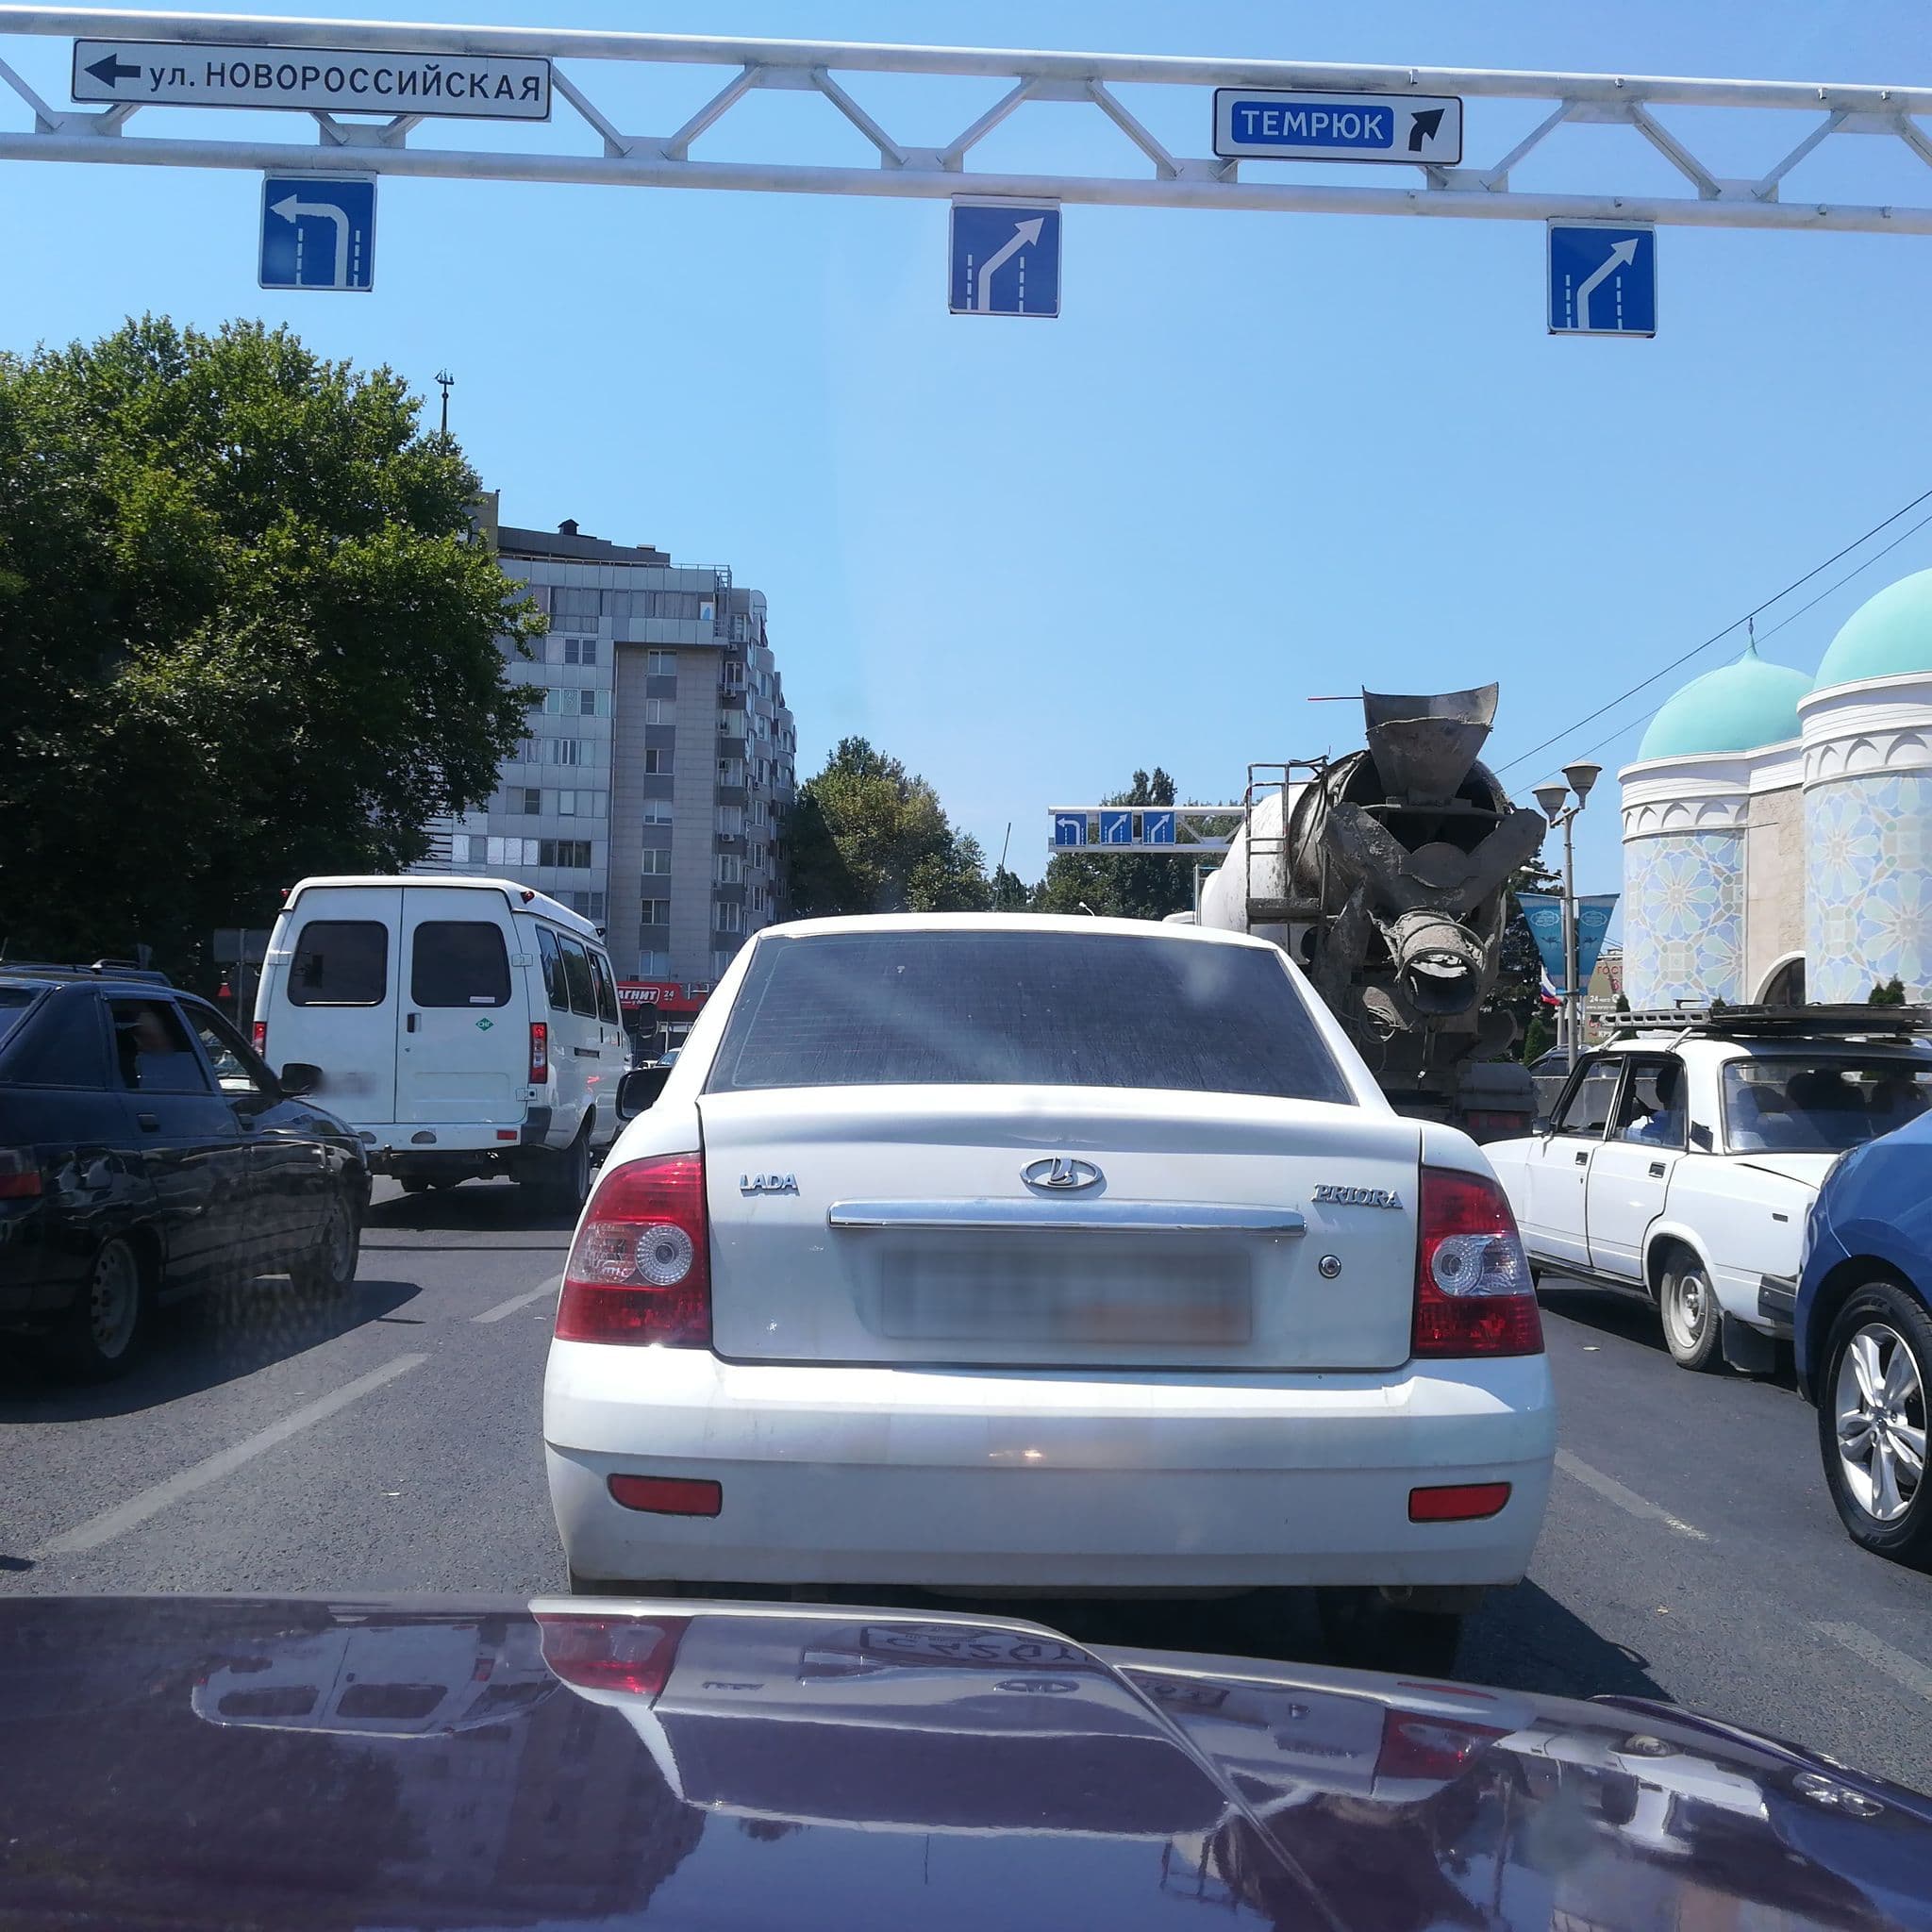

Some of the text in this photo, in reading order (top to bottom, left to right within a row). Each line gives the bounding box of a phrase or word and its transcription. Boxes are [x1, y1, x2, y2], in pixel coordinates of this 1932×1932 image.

[149, 61, 540, 101] ул. НОВОРОССИЙСКАЯ
[1241, 109, 1384, 140] ТЕМРЮК
[617, 990, 658, 1001] АГНИТ
[740, 1173, 800, 1197] LADA
[1310, 1183, 1404, 1209] PRIORA
